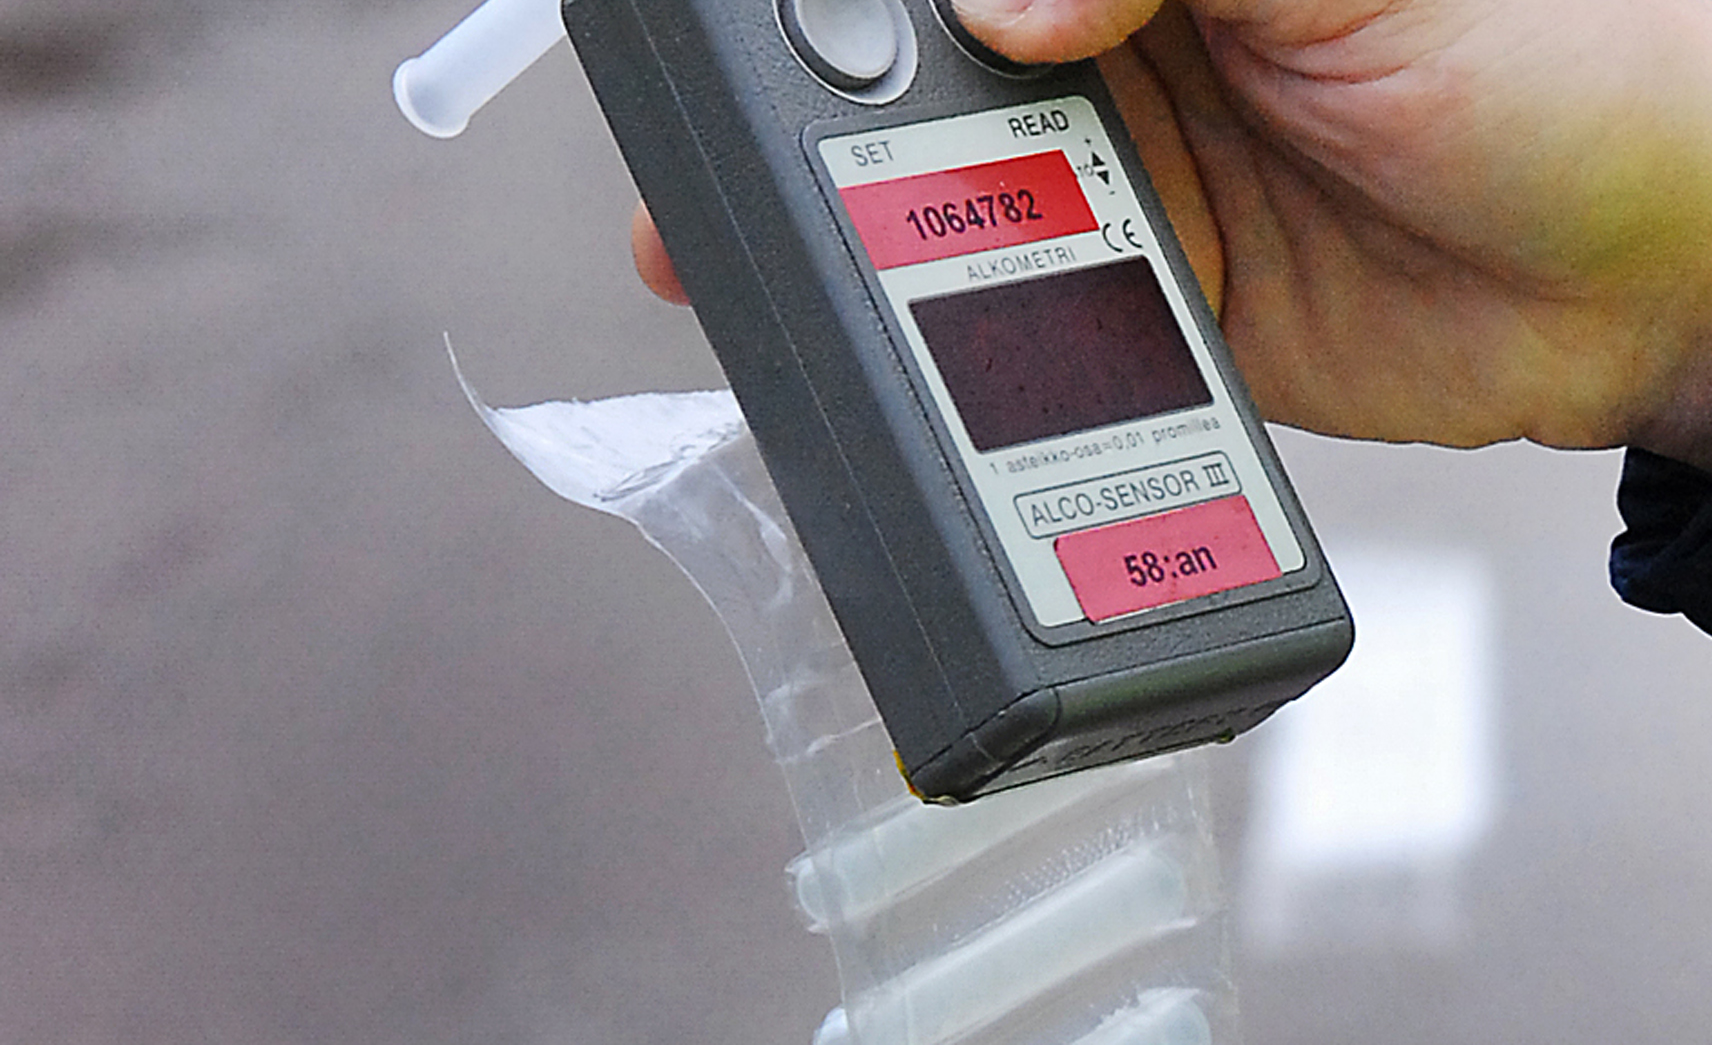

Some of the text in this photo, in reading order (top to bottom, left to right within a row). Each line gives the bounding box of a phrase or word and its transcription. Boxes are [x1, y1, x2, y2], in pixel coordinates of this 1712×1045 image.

[1008, 109, 1069, 138] READ
[851, 141, 894, 167] SET
[907, 189, 1043, 240] 1064782
[967, 247, 1076, 281] ALKOMETRI
[1031, 463, 1230, 526] ALCO-SENSOR III
[1125, 545, 1217, 588] 58:an
